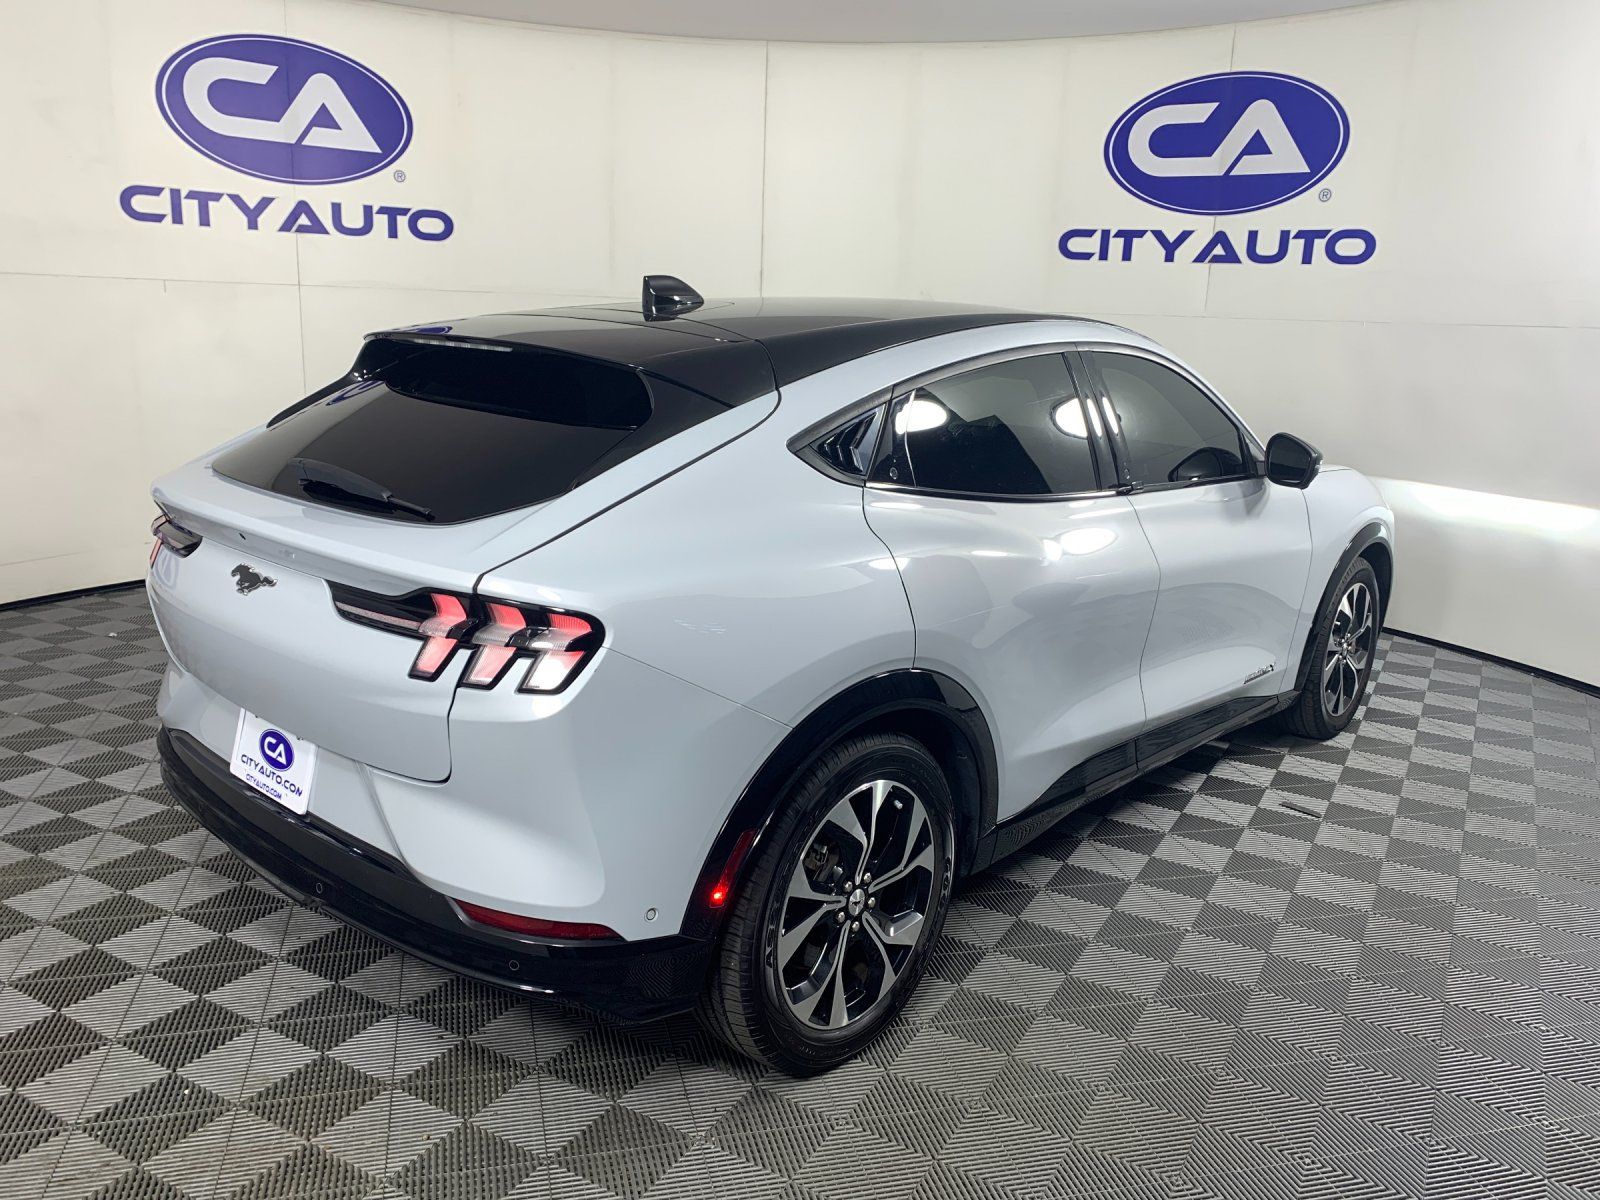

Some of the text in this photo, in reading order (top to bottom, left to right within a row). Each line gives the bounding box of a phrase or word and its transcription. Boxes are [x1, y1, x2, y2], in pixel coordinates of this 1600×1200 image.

[183, 56, 383, 154] CA
[1127, 98, 1311, 178] CA
[263, 736, 287, 765] CA
